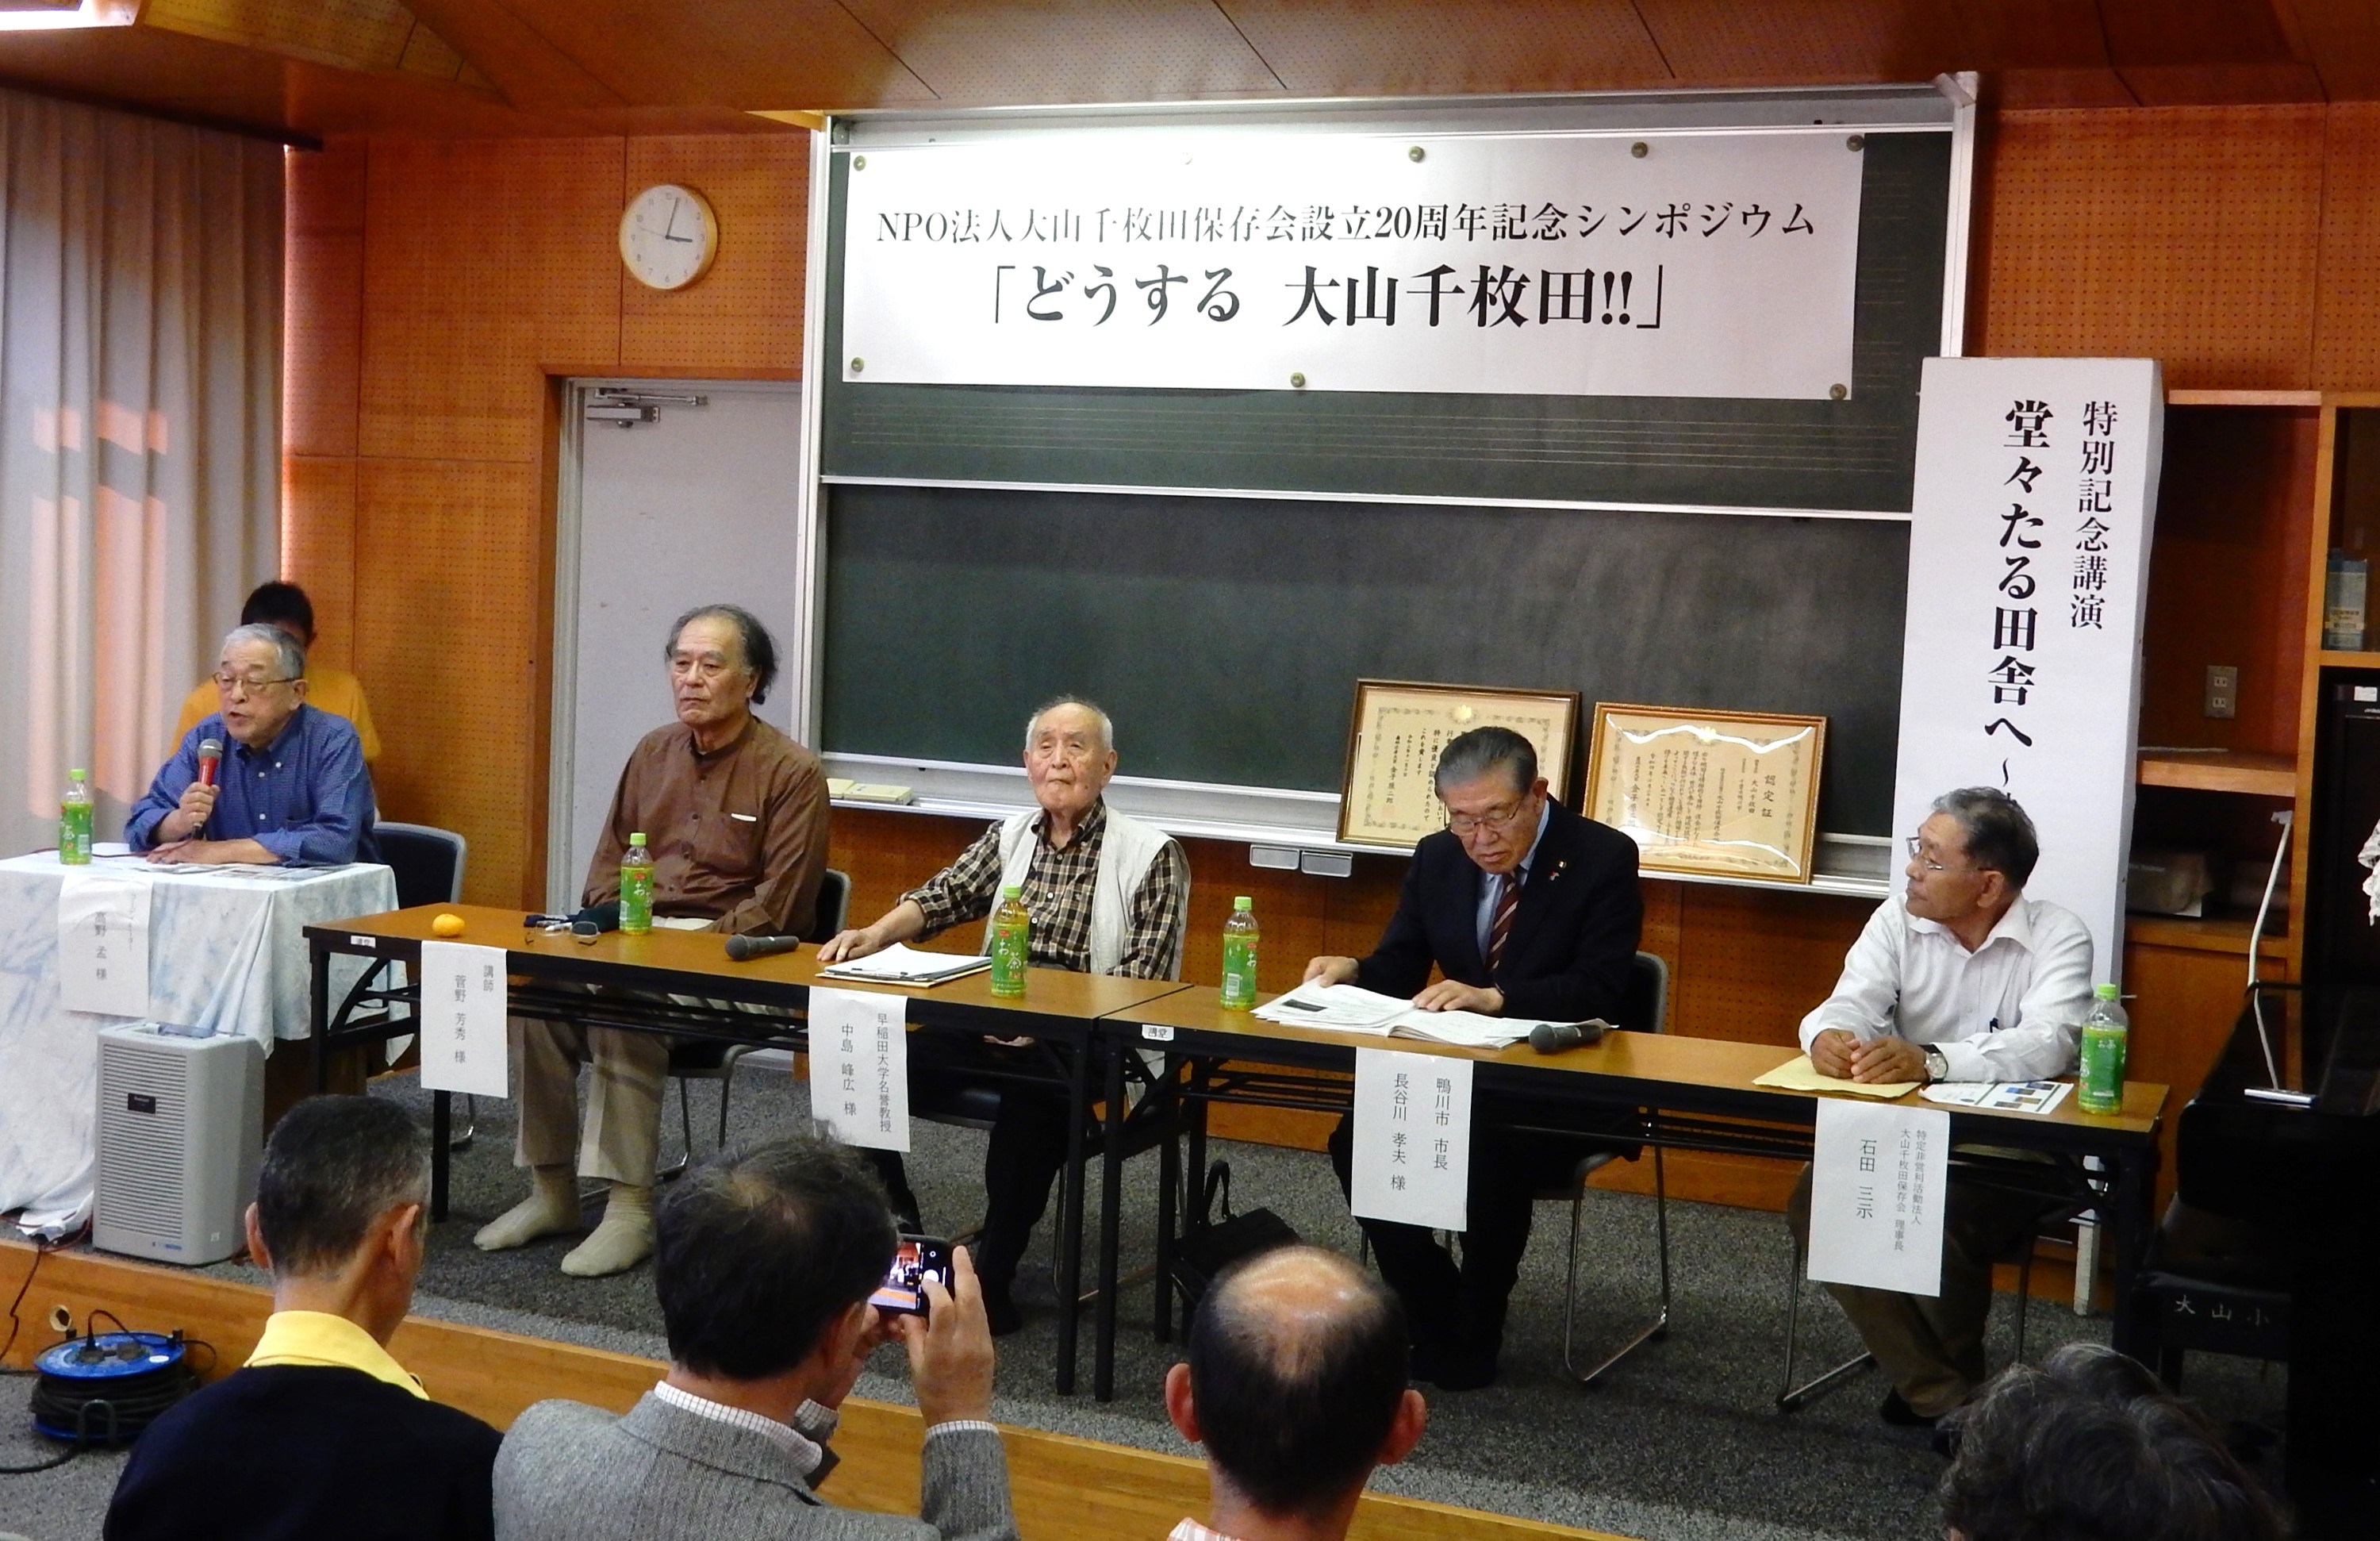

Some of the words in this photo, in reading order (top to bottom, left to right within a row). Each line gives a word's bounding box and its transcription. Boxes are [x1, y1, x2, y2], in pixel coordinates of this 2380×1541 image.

[877, 203, 1814, 243] NPO法人大山千枚田保存会設立20周年記念シンポジウム
[995, 263, 1240, 327] 「どうする
[2069, 400, 2119, 631] 特別記念講演
[455, 974, 466, 1003] 菅野
[482, 964, 495, 993] 講師
[455, 1013, 466, 1041] 芳秀
[841, 1023, 854, 1054] 中島
[454, 1050, 466, 1064] 様
[877, 1013, 892, 1133] 早稲田大学名誉教授
[841, 1062, 855, 1092] 峰広
[843, 1101, 857, 1116] 様
[1392, 1073, 1409, 1121] 長谷川
[1434, 1077, 1451, 1127] 鴨川市
[1392, 1132, 1407, 1165] 孝夫
[1433, 1137, 1449, 1170] 市長
[1859, 1138, 1878, 1173] 石田
[1390, 1174, 1406, 1191] 様
[1896, 1128, 1911, 1213] 大山千枚田保存会
[1911, 1129, 1927, 1225] 特定非営利活動法人
[1856, 1186, 1874, 1220] 三示
[1894, 1219, 1906, 1251] 理事長
